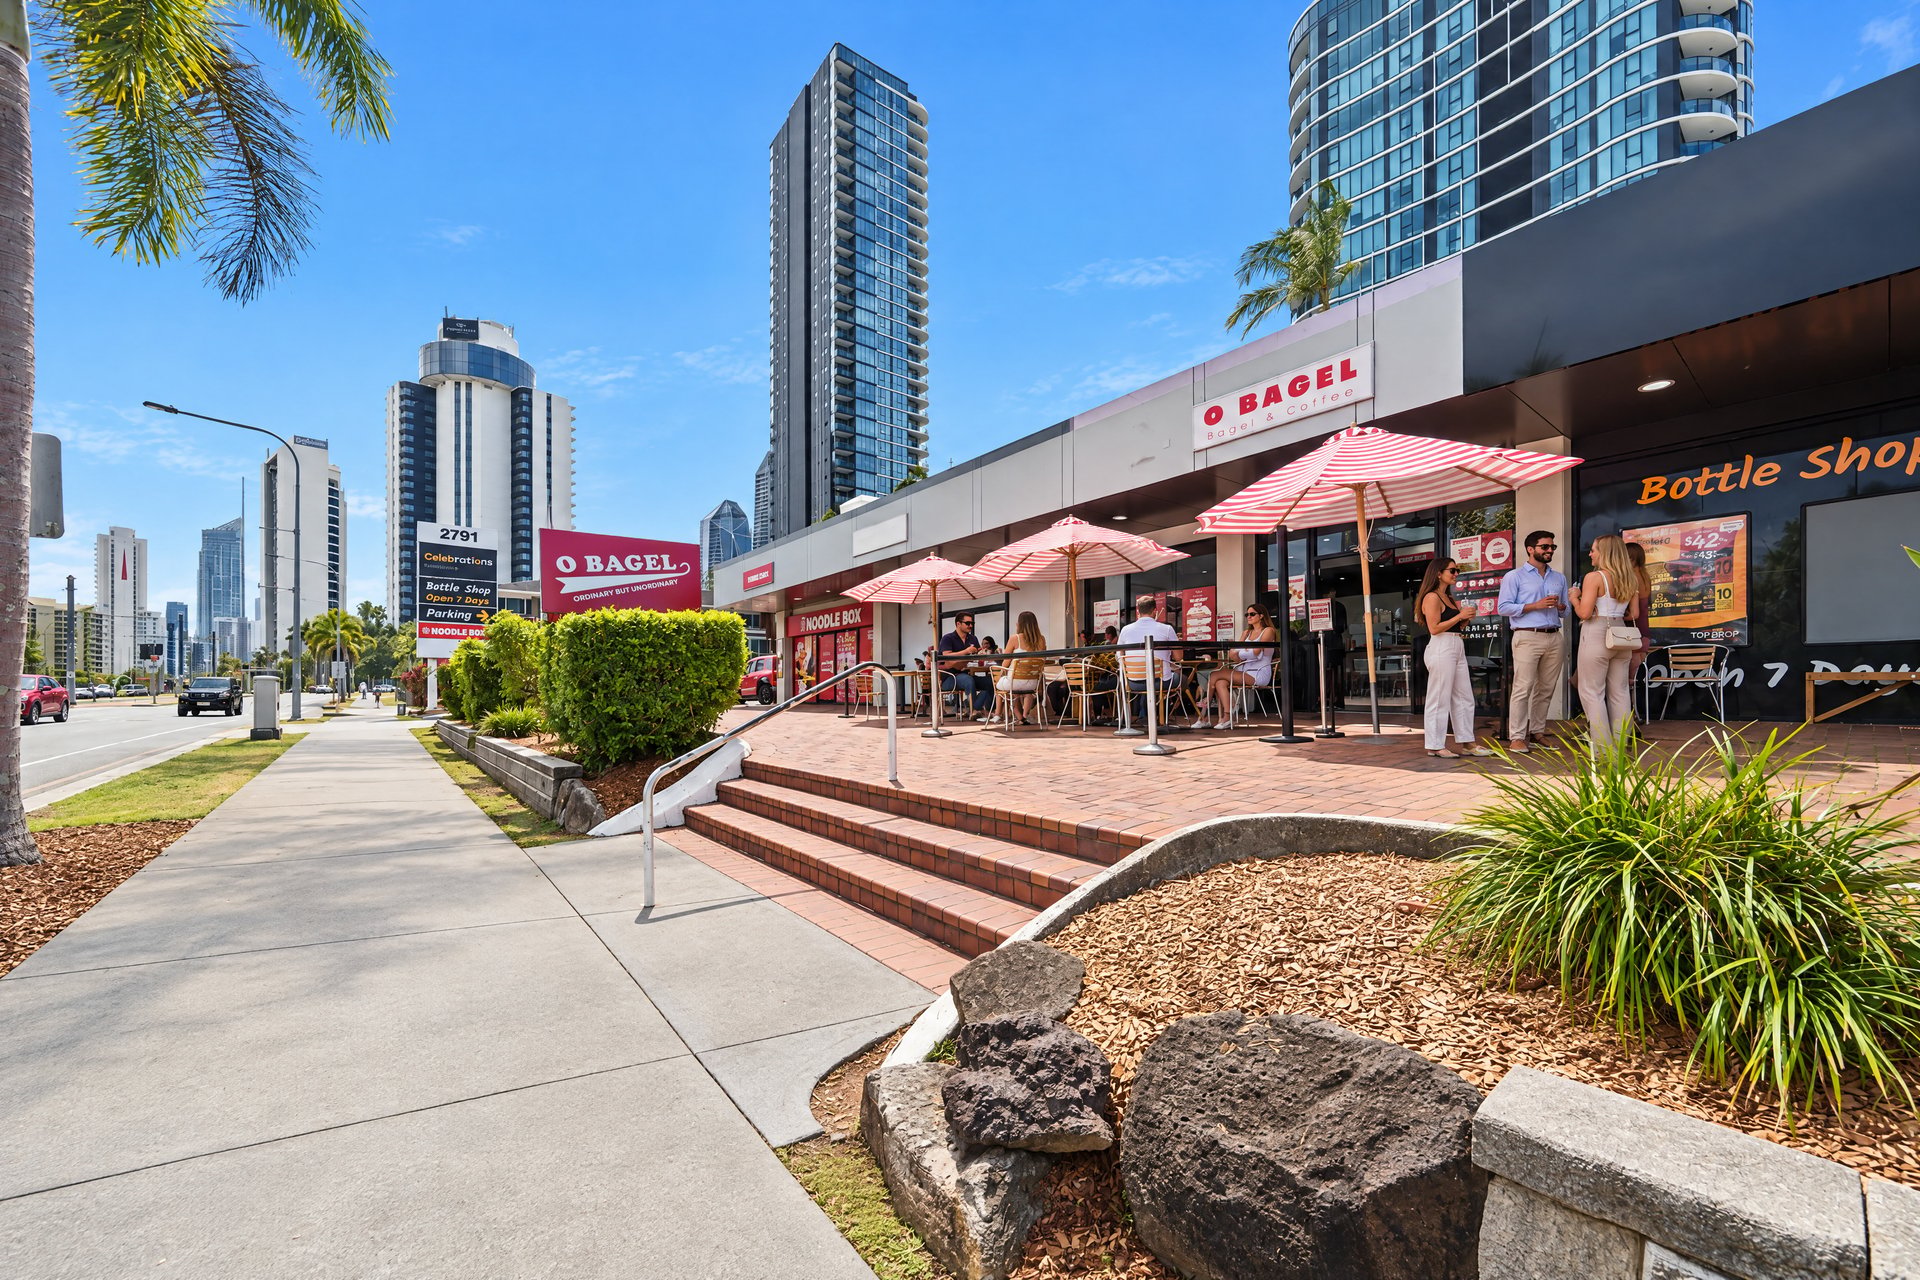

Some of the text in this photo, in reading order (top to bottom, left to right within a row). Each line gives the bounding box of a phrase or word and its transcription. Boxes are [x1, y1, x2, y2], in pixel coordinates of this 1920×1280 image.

[1203, 358, 1357, 426] O BAGEL
[1207, 388, 1354, 441] Bagel & Coffee
[1636, 454, 1782, 505] Bottle
[440, 528, 478, 543] 2791
[424, 552, 493, 566] Celebrations
[555, 554, 677, 573] O BAGEL
[426, 581, 491, 597] Bottle Shop
[573, 579, 679, 602] ORDINARY BUT UNORDINARY
[1716, 587, 1732, 600] 10
[426, 593, 490, 606] Open 7 Days
[426, 608, 472, 622] Parking
[806, 607, 862, 632] NOODLE BOX
[431, 627, 468, 636] NOODLE
[1690, 631, 1711, 639] TOP
[1763, 662, 1789, 688] 7
[1810, 660, 1920, 697] Day
